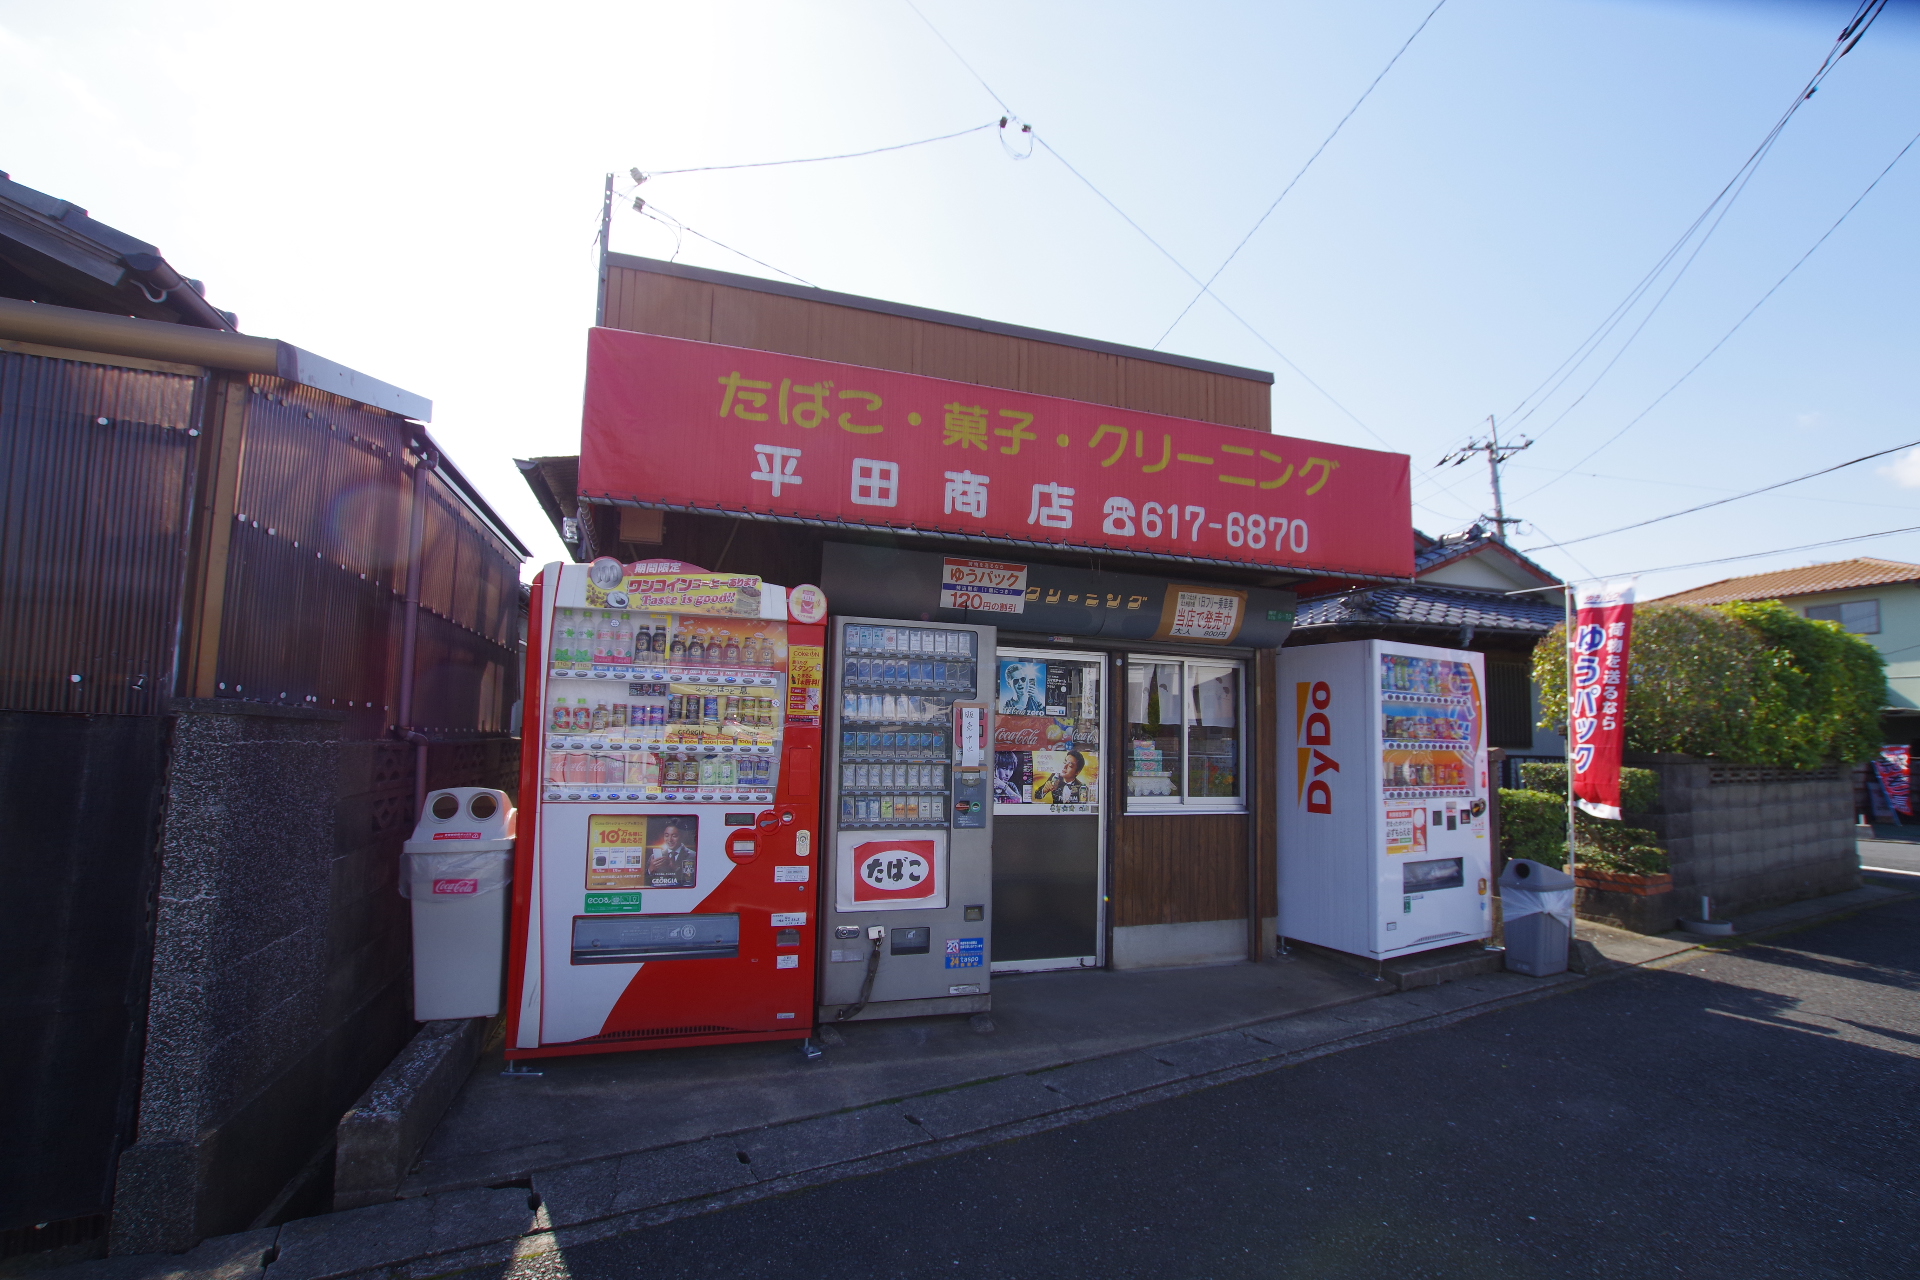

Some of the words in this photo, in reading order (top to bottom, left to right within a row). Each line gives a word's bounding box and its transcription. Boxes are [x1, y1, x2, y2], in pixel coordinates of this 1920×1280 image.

[750, 443, 1076, 529] 平田商店
[634, 562, 682, 573] 期間限定
[950, 567, 1020, 588] ゆうパック
[627, 576, 761, 595] ワンコインコーヒーあります
[641, 594, 678, 606] Taste
[681, 593, 694, 605] is
[950, 591, 1017, 613] 120円の割引
[1601, 621, 1626, 731] 荷物を送るなら
[1572, 622, 1607, 775] ゆうパック
[1306, 680, 1341, 815] DyDo
[866, 857, 922, 884] たばこ
[435, 881, 475, 893] Coca-Cola
